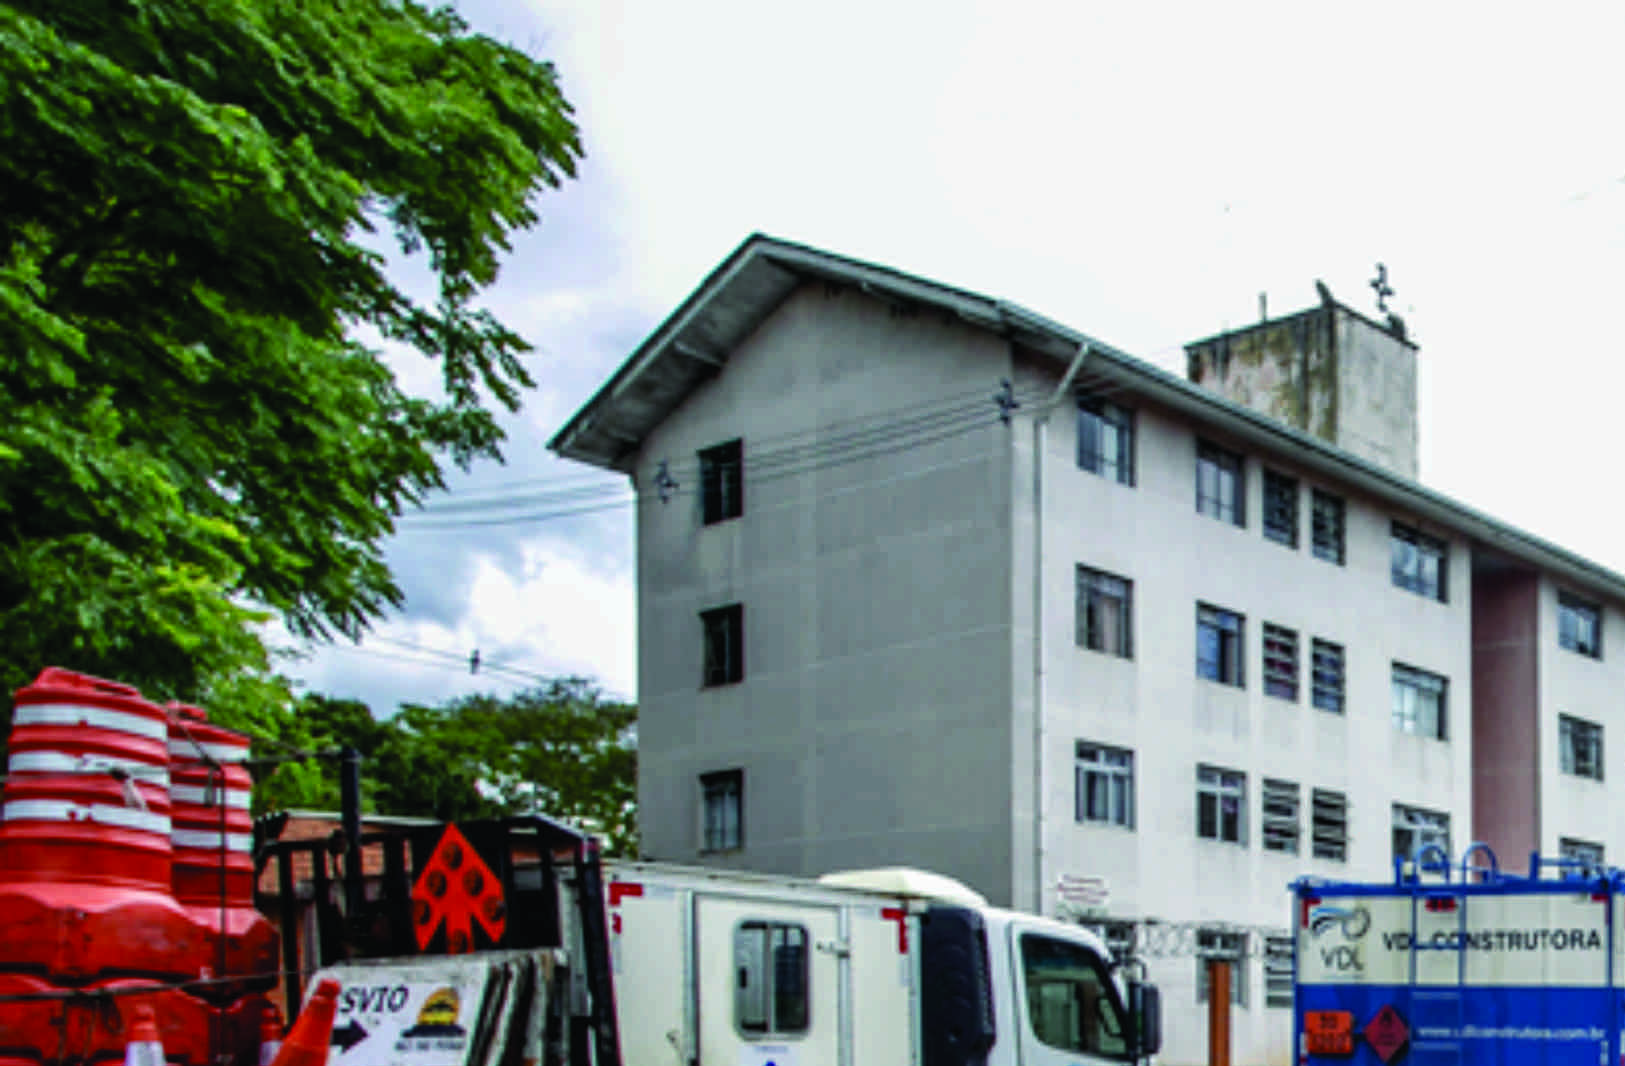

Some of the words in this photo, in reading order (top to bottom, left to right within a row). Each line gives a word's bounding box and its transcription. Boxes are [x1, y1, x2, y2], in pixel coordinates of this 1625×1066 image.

[1430, 928, 1602, 952] CONSTRUTORA
[1320, 945, 1365, 972] VDL
[340, 983, 410, 1014] SVIO
